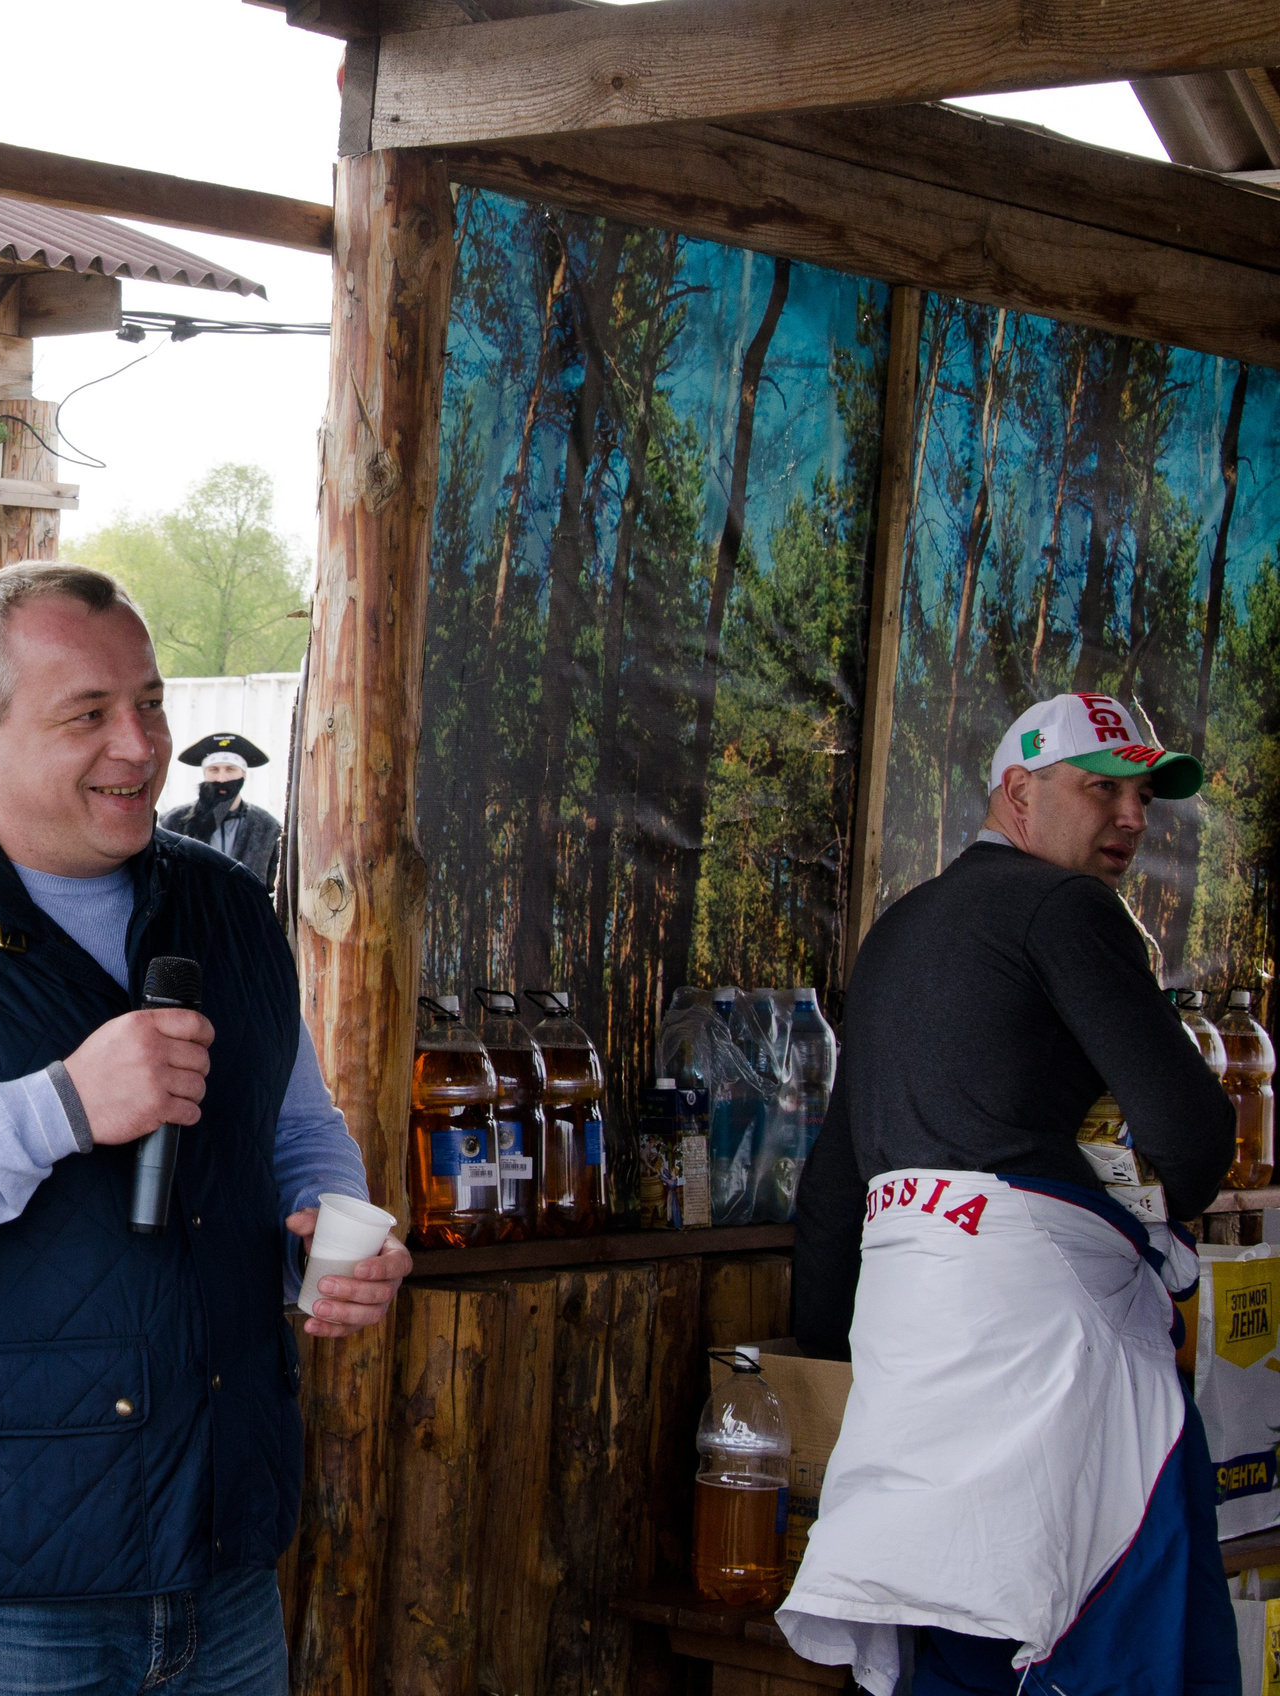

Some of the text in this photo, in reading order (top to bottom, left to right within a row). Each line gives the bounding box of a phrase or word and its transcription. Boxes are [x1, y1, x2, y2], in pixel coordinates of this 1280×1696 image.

[863, 1178, 989, 1236] USSIA
[1231, 1288, 1267, 1311] ЭТО МОЯ
[1229, 1308, 1269, 1339] ЛЕНТА
